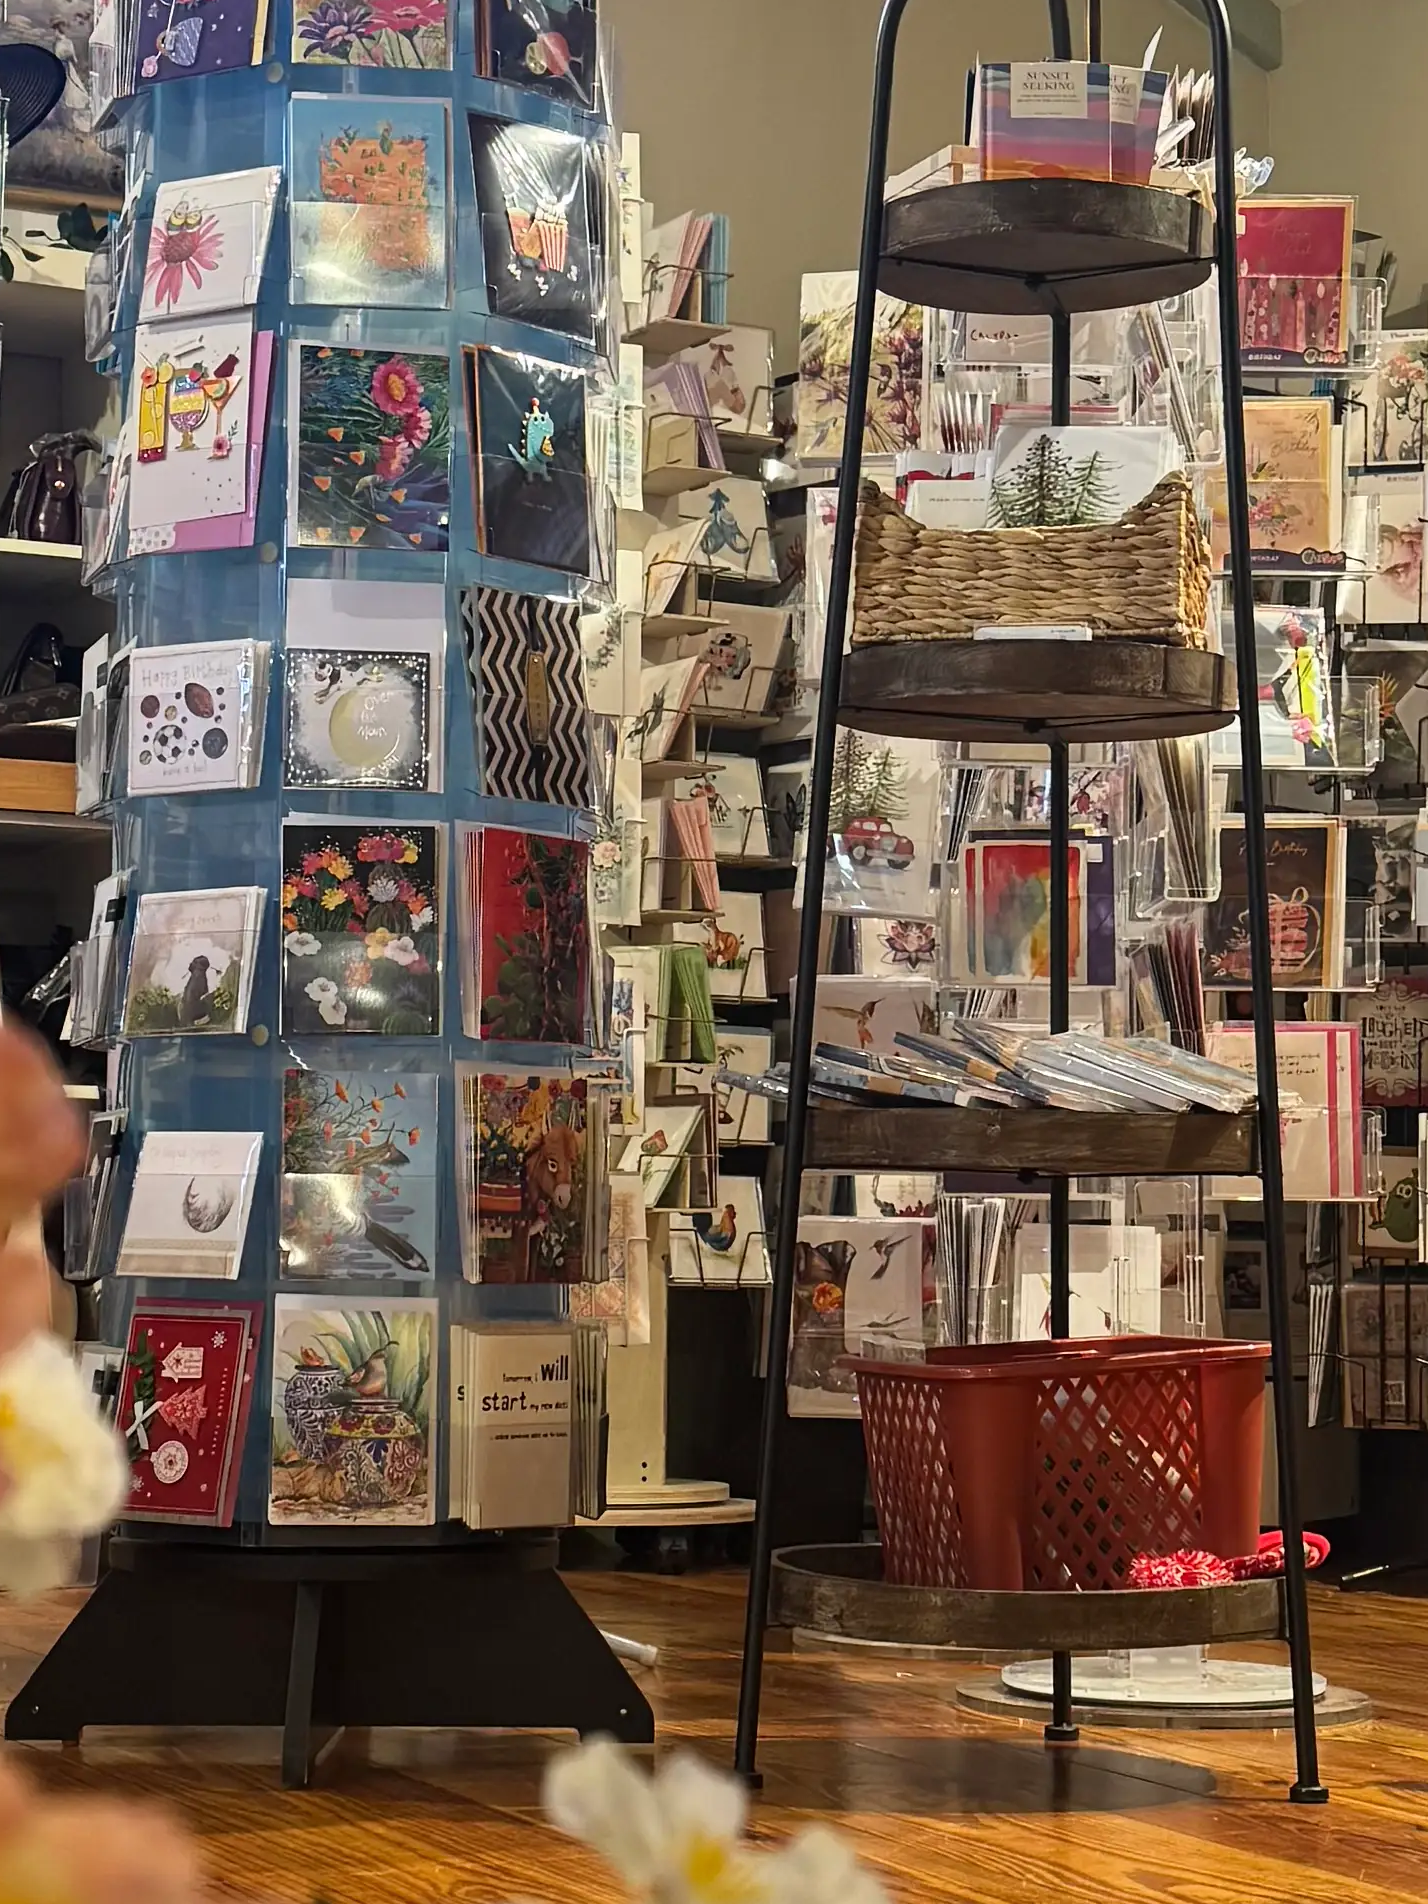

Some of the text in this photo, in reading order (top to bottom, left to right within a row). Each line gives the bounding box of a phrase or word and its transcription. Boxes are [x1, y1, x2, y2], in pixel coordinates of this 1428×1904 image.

[1026, 71, 1070, 81] SUNSET
[1023, 82, 1075, 91] SEEKING
[540, 1355, 569, 1381] will
[482, 1391, 527, 1412] start
